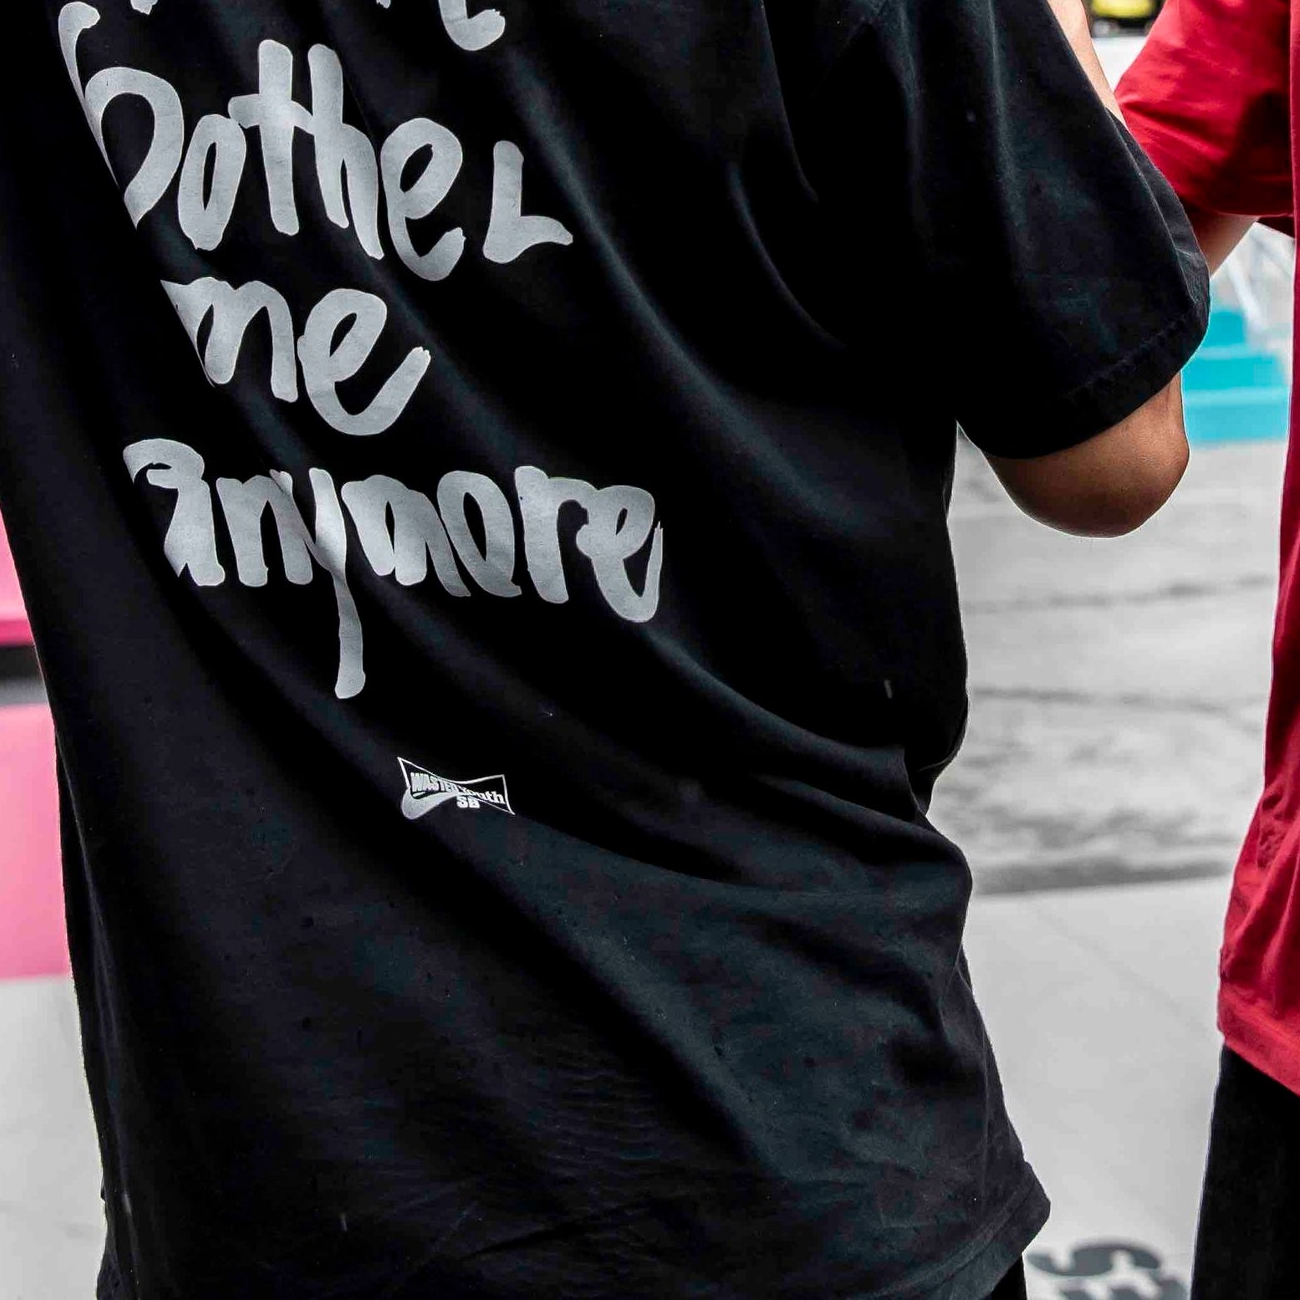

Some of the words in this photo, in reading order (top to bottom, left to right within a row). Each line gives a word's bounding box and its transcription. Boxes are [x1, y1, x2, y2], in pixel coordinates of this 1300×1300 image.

[159, 276, 433, 437] me
[122, 437, 665, 699] anymore
[410, 771, 459, 794] WASTED
[456, 795, 481, 809] SB
